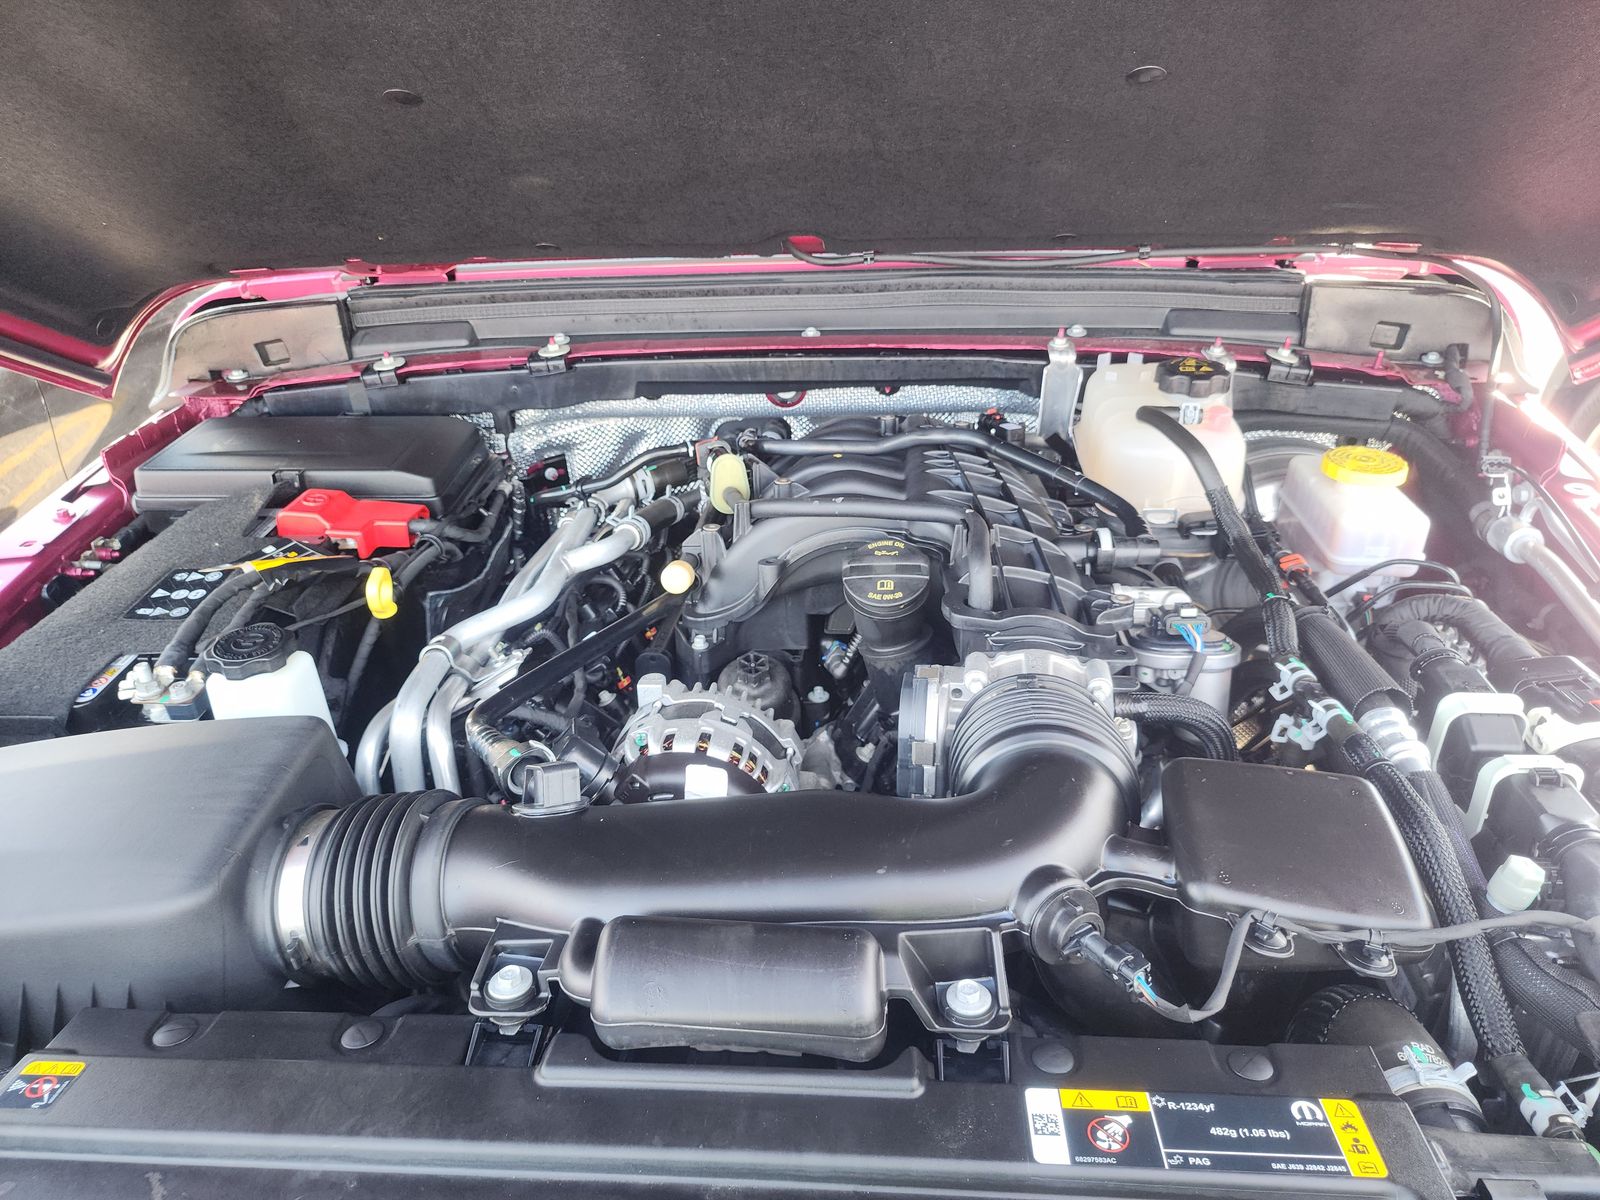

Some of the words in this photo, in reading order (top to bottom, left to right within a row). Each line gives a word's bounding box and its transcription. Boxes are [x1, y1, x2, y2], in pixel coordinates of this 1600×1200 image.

[868, 540, 893, 550] ENGINE
[894, 541, 905, 549] OIL
[867, 591, 882, 600] SAE
[1168, 1101, 1215, 1113] R-1234yf
[1210, 1126, 1238, 1138] 482g
[1239, 1127, 1267, 1138] (1.06
[1269, 1128, 1291, 1140] lbs)
[1188, 1157, 1211, 1166] PAG
[1271, 1162, 1287, 1170] SAE
[1288, 1163, 1304, 1171] J639
